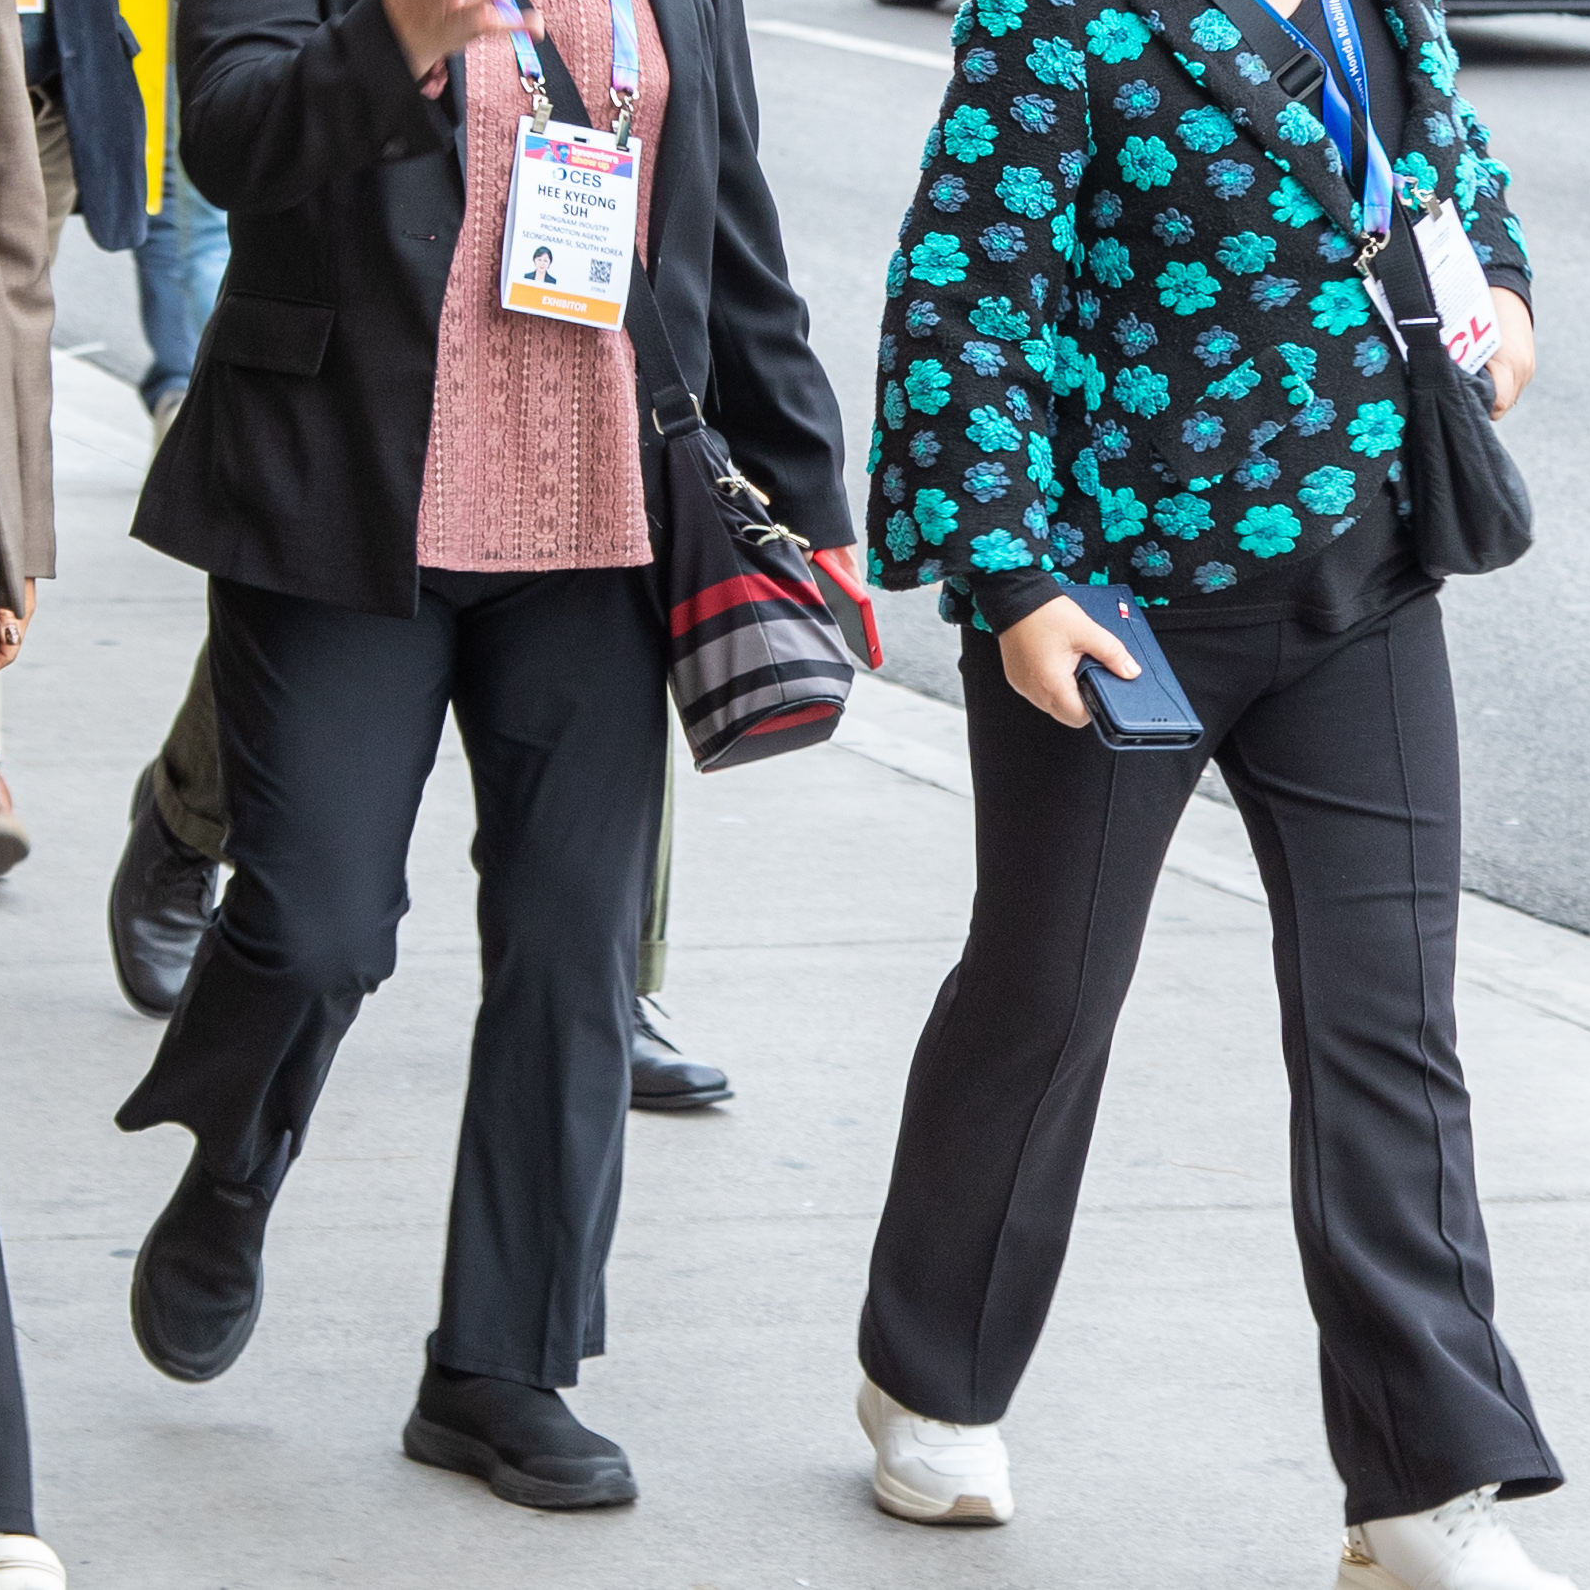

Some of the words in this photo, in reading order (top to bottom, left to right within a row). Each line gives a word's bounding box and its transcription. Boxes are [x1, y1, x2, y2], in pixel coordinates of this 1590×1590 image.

[1341, 38, 1360, 78] Honda
[570, 170, 602, 188] CES
[538, 184, 561, 199] HEE
[565, 190, 616, 210] KYEONG
[563, 203, 588, 218] SUH
[540, 213, 577, 226] SEONGNAM
[579, 219, 610, 232] INDUSTRY
[540, 223, 580, 237] PROMOTION
[582, 232, 607, 242] AGENCY
[575, 241, 599, 252] SOUTH
[601, 246, 623, 257] KOREA
[541, 295, 588, 313] EXHIBITOR
[1446, 315, 1492, 365] CL
